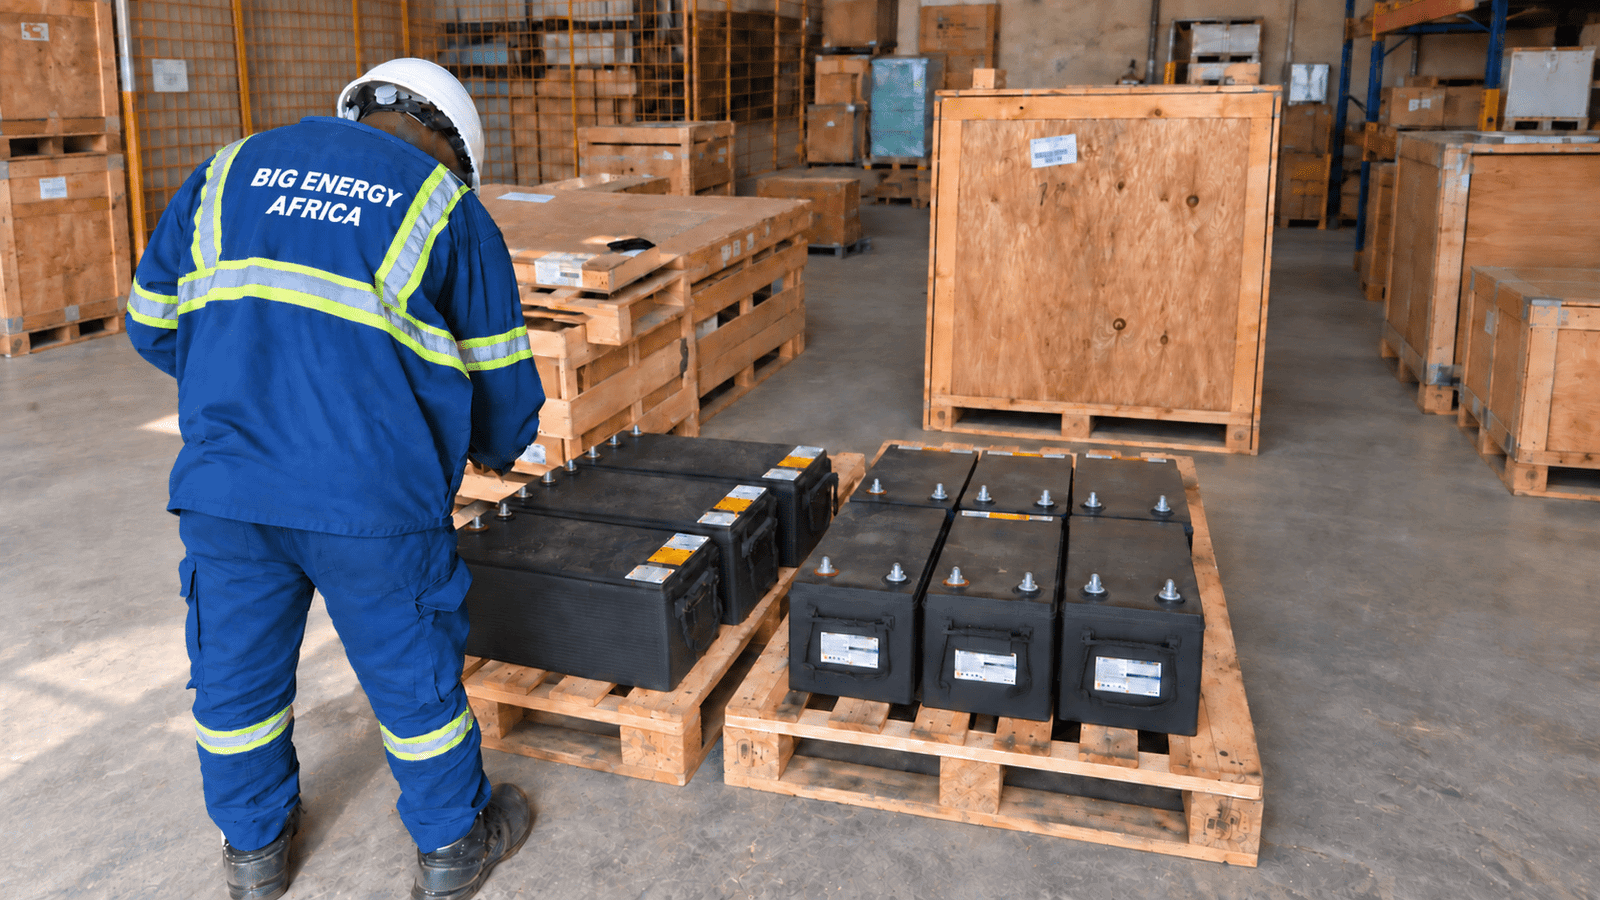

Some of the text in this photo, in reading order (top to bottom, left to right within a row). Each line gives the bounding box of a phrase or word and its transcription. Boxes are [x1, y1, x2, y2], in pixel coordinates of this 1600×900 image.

[251, 168, 403, 208] BIG ENERGY
[265, 195, 362, 227] AFRICA
